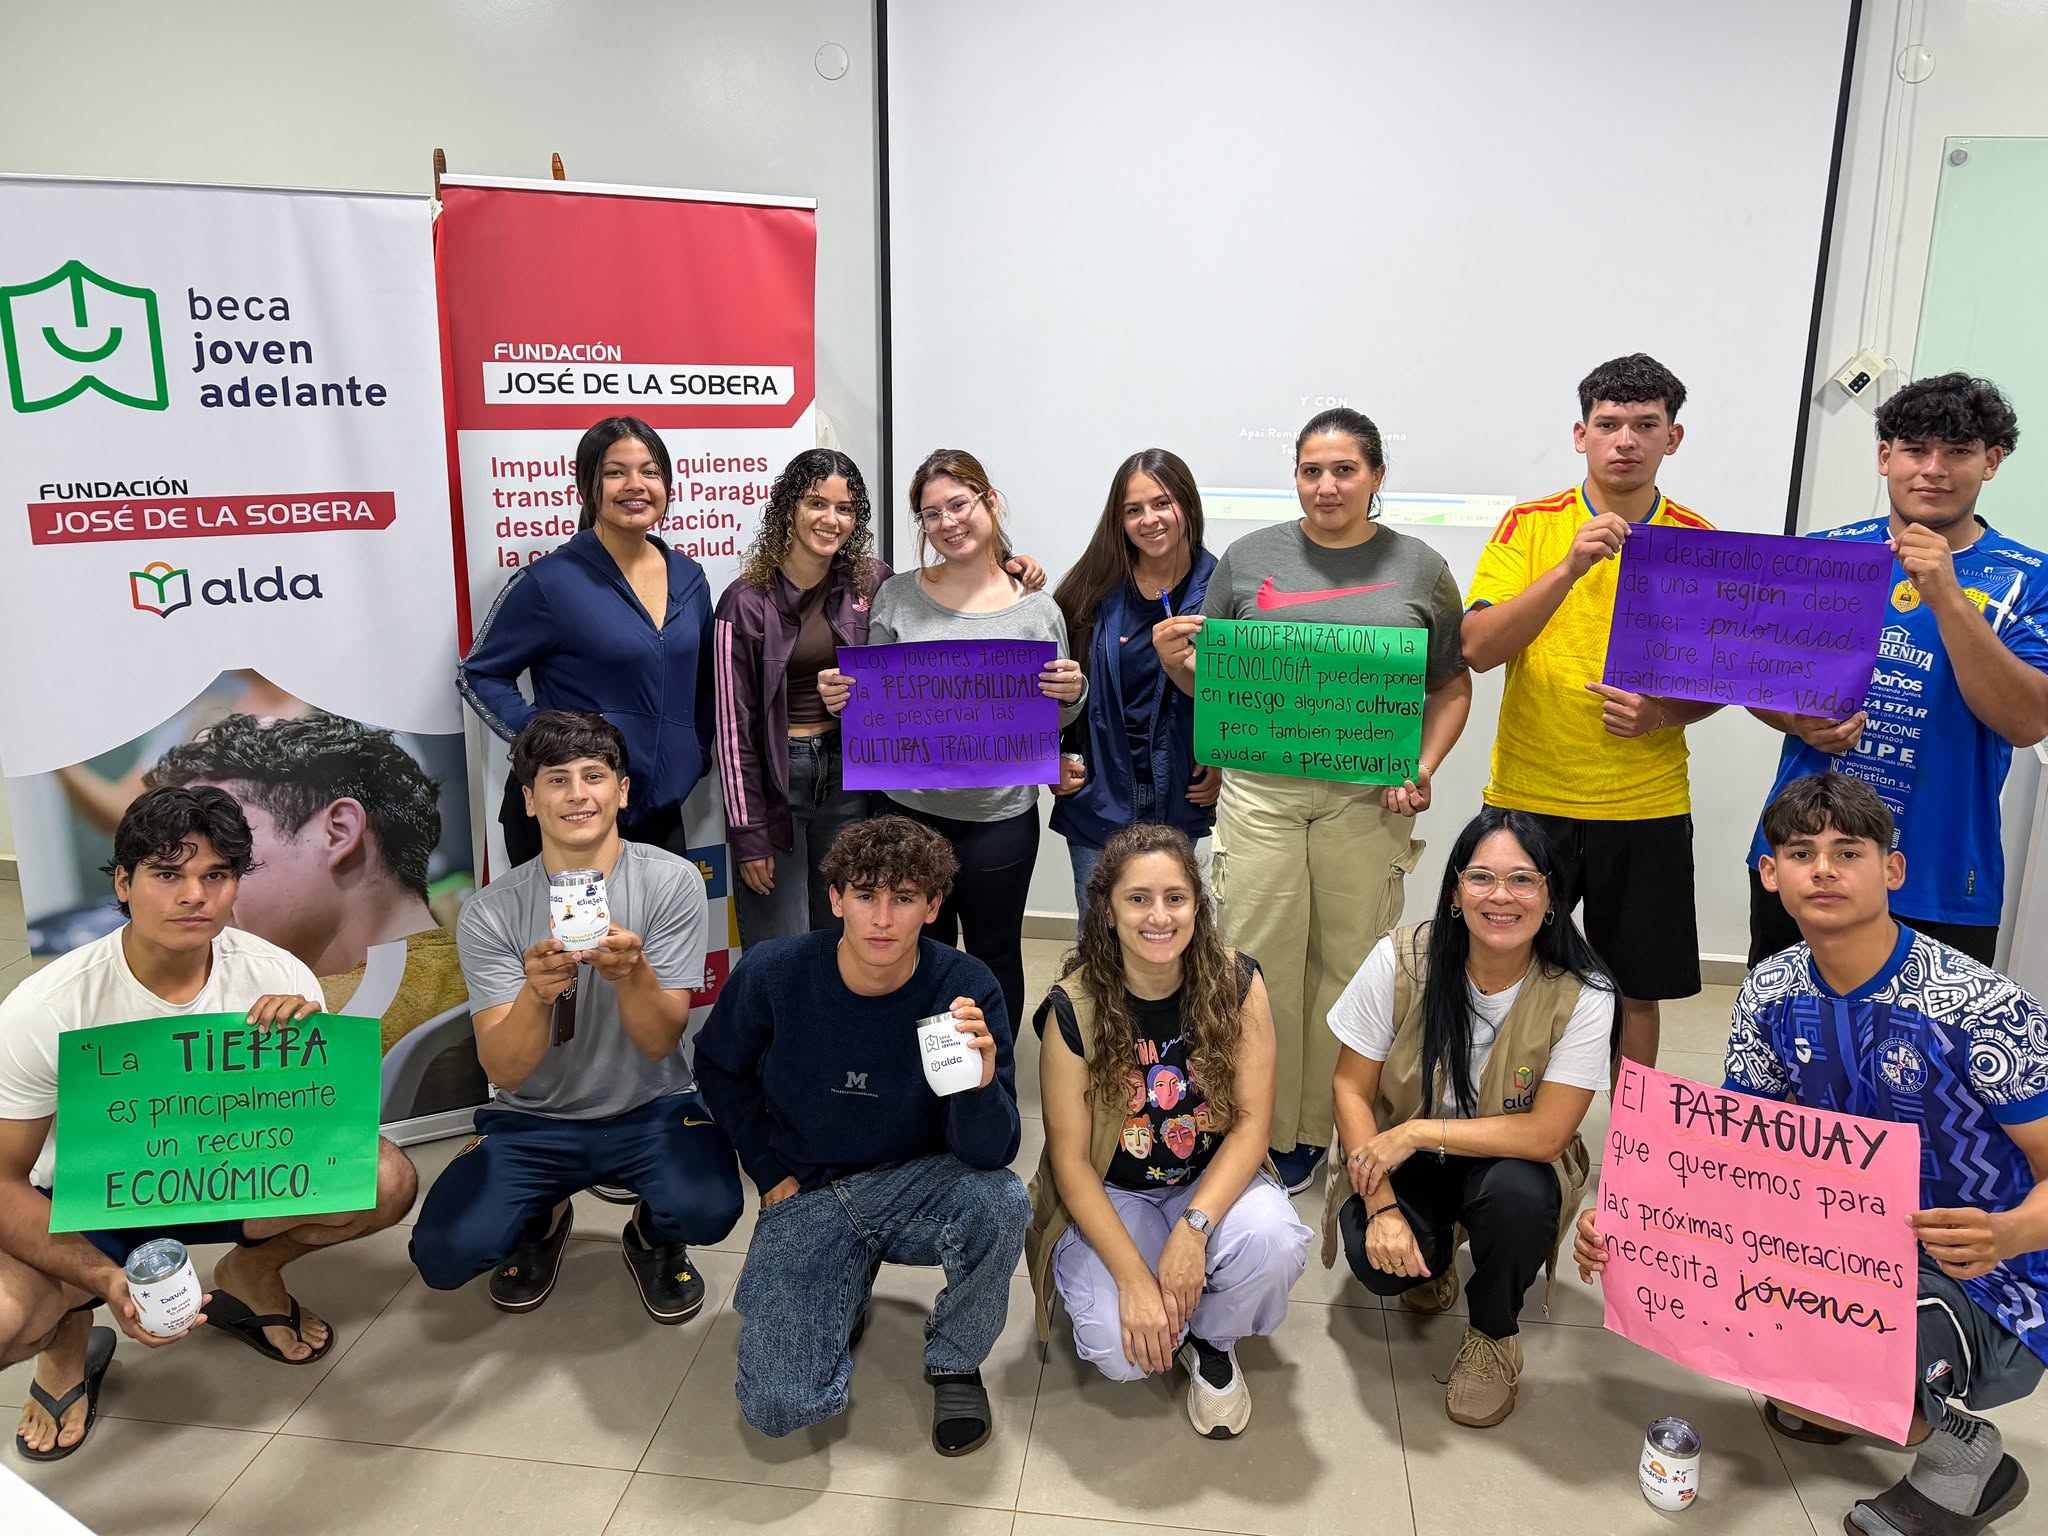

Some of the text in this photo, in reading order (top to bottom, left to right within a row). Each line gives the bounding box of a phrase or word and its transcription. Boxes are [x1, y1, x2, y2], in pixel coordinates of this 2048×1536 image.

[188, 287, 290, 321] beca
[192, 332, 313, 373] joven
[494, 341, 621, 361] FUNDACIÓN
[200, 376, 387, 408] adelante
[499, 368, 778, 395] JOSÉ DE LA SOBERA
[1315, 396, 1348, 407] CON
[491, 452, 768, 482] Impuls quienes
[39, 476, 188, 499] FUNDACIÓN
[492, 484, 583, 508] transf
[690, 482, 776, 505] Paragu
[47, 500, 375, 535] JOSÉ DE LA SOBERA
[496, 515, 575, 539] desde
[498, 546, 520, 568] la
[1664, 537, 1763, 572] desarrollo
[1772, 555, 1880, 583] económico
[201, 566, 323, 605] alda
[1624, 571, 1863, 613] de una región debe
[1621, 601, 1684, 630] tener
[1382, 640, 1390, 659] y
[1400, 631, 1415, 654] la
[1642, 638, 1815, 679] sobre las formas
[1879, 642, 1934, 671] RENITA
[903, 648, 970, 673] jóvenes
[981, 648, 1040, 667] tienen
[1203, 652, 1425, 692] TECNOLOGÍA pueden poner
[854, 672, 1041, 702] la RESPONSABILIDAD
[1608, 661, 1736, 699] tradicionales
[1748, 682, 1774, 705] de
[1200, 687, 1221, 702] en
[1228, 690, 1285, 714] riesgo
[1294, 694, 1352, 716] algunas
[1883, 702, 1928, 718] STAR
[863, 705, 1014, 730] de preservar las
[1865, 719, 1921, 739] WZONE
[1219, 720, 1394, 746] pero también pueden
[1863, 731, 1903, 744] MPORTADOS
[850, 736, 931, 765] CULTURAS
[1211, 747, 1267, 764] ayudar
[1282, 751, 1293, 764] a
[1845, 767, 1896, 786] Cristian
[1847, 761, 1885, 773] NOVEDADES
[845, 1071, 869, 1089] M
[107, 1081, 336, 1128] es principalmente
[1503, 1090, 1534, 1110] ald
[146, 1126, 294, 1157] un recurso
[1669, 1084, 1888, 1170] PARAGUAY
[1611, 1131, 1886, 1219] que queremos para
[1604, 1182, 1903, 1289] las próximas generaciones
[160, 1287, 187, 1304] David
[1604, 1233, 1897, 1334] necesita jóvenes
[1637, 1286, 1685, 1321] que
